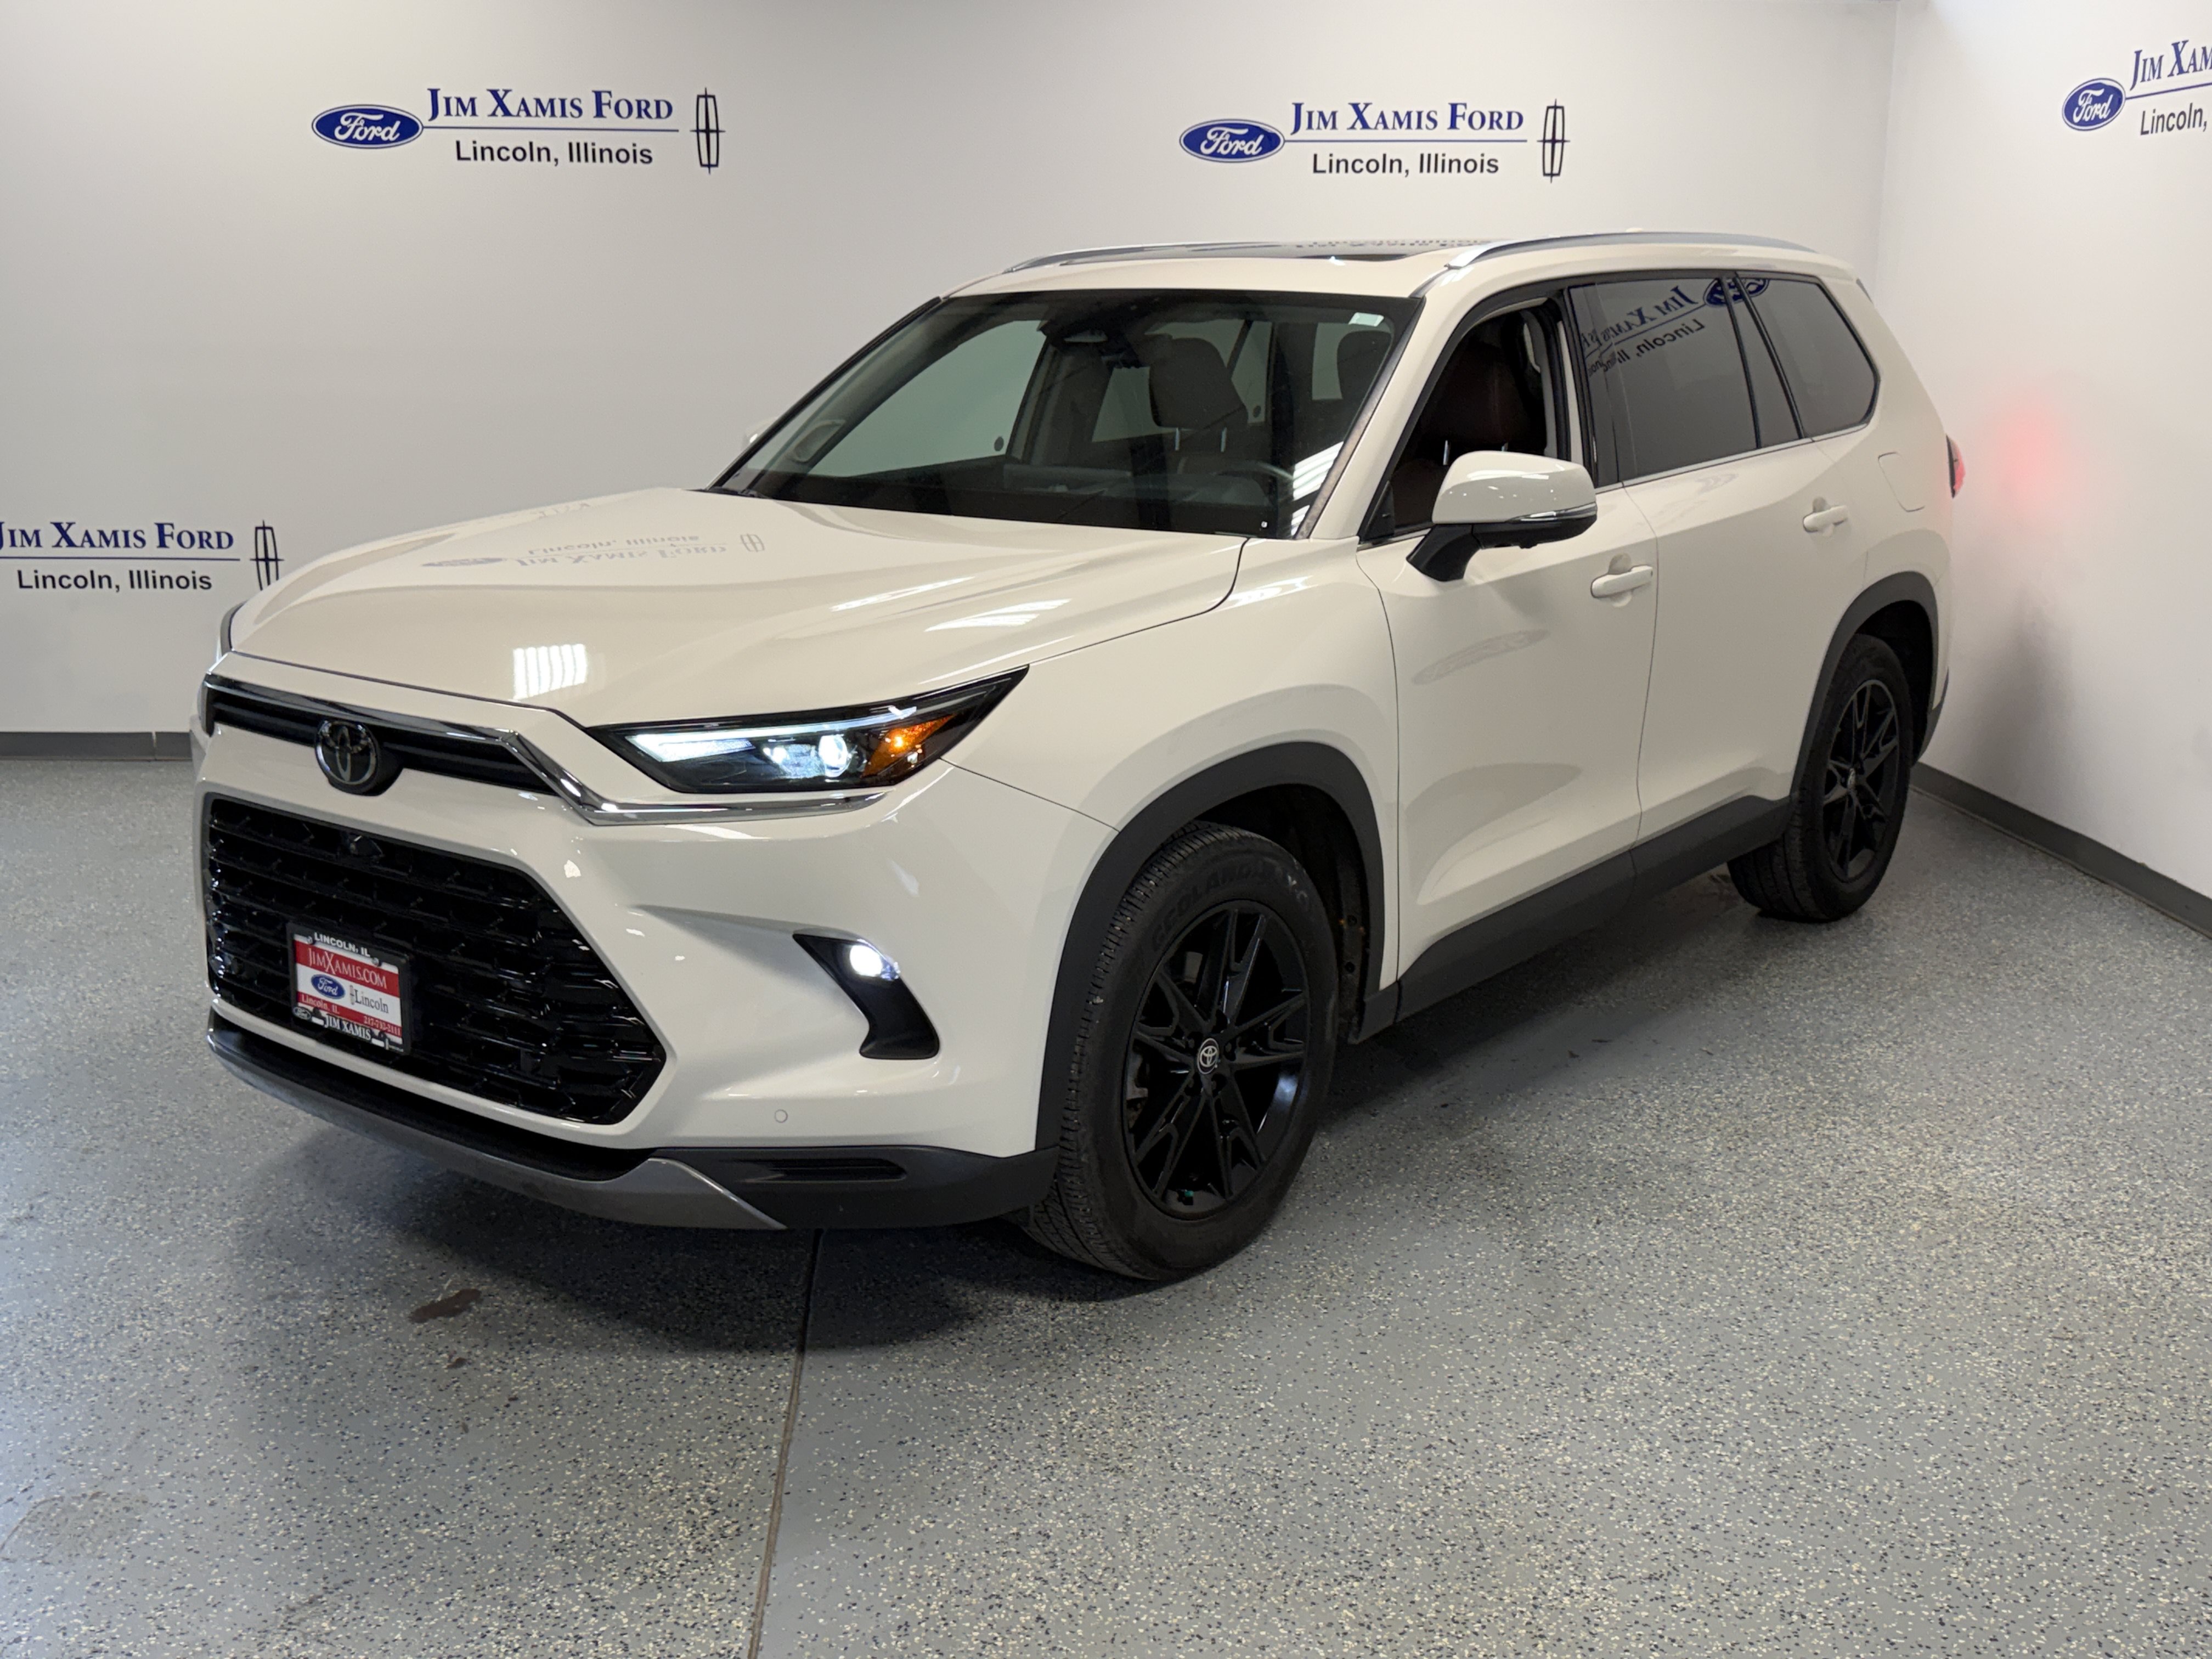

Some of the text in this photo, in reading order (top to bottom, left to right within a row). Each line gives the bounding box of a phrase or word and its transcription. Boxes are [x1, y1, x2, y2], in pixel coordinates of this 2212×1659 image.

[2130, 49, 2164, 91] JIM
[427, 88, 674, 121] JIM XAMIS FORD
[1291, 102, 1523, 136] JIM XAMIS FORD
[2140, 102, 2207, 136] Lincoln,
[456, 140, 653, 166] Lincoln, Illinois
[1312, 153, 1499, 177] Lincoln, Illinois
[50, 522, 146, 549] XAMIS
[154, 522, 234, 549] FORD
[17, 569, 212, 592] Lincoln, Illinois
[314, 932, 371, 957] LINCOLN, IL
[355, 989, 389, 1014] Lincoln
[324, 1013, 371, 1041] JIM XAMIS
